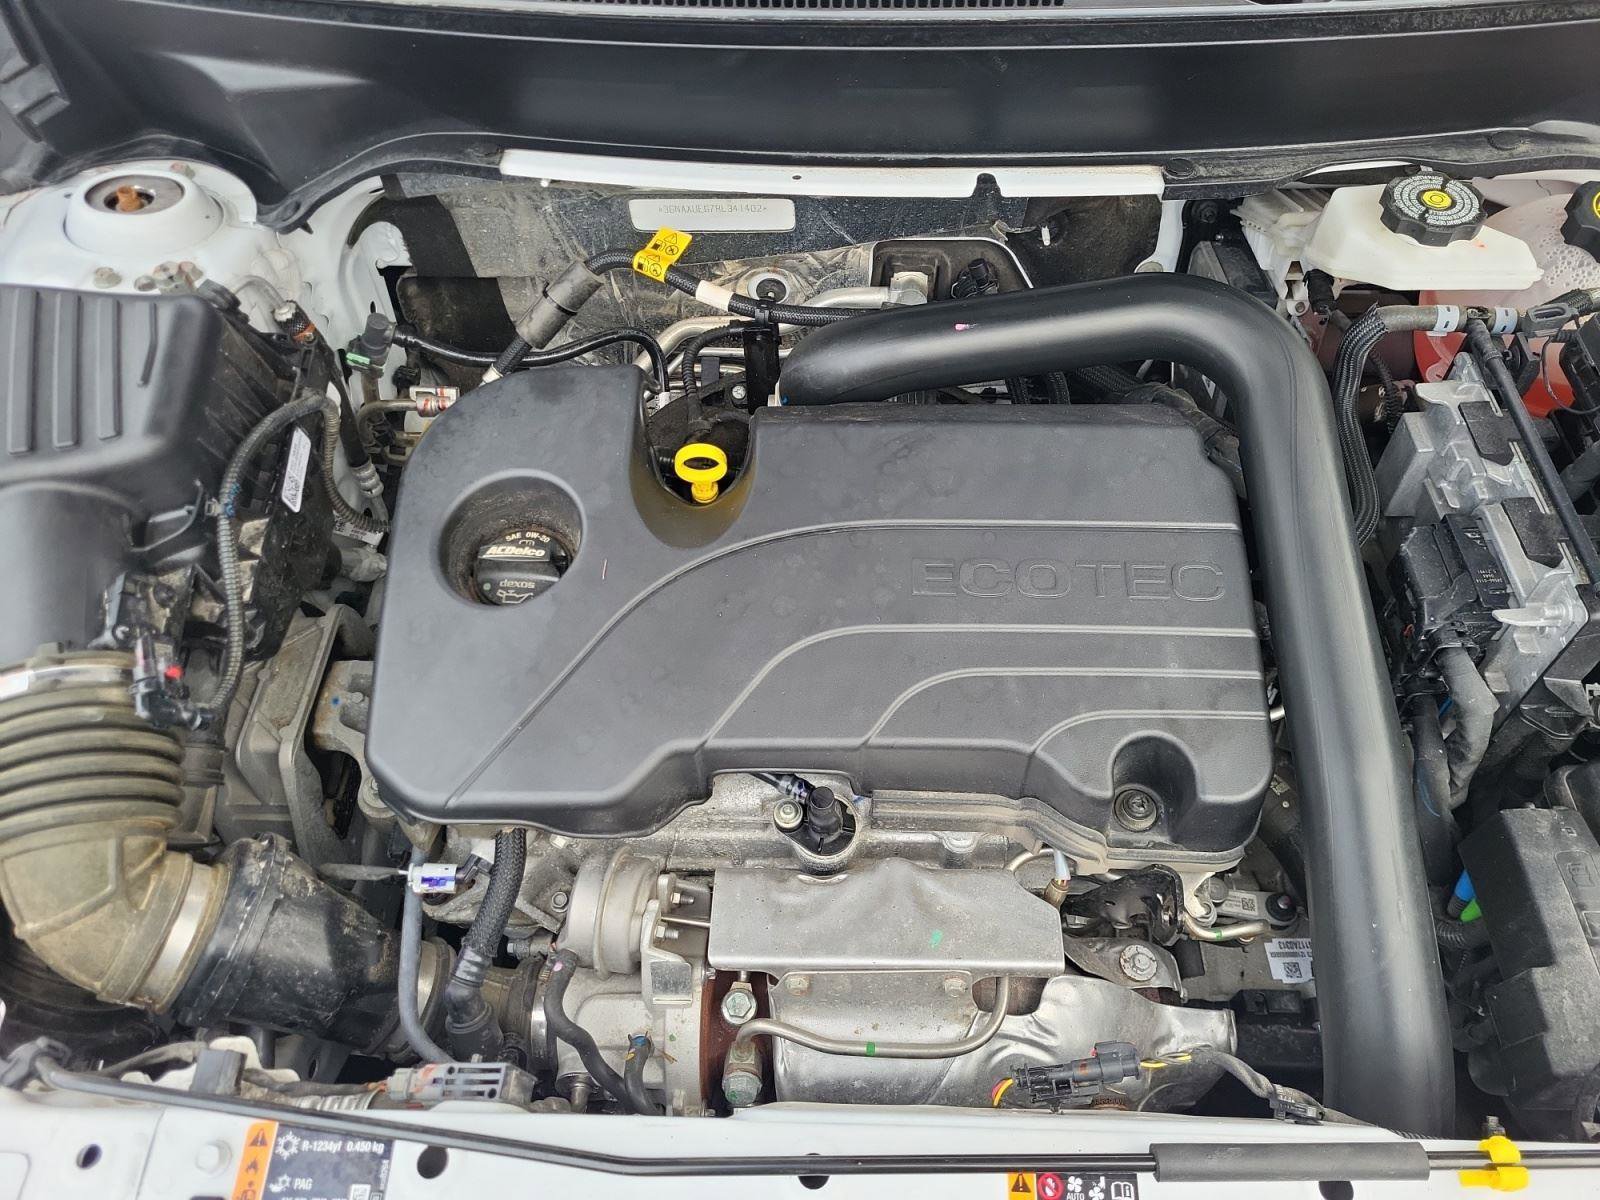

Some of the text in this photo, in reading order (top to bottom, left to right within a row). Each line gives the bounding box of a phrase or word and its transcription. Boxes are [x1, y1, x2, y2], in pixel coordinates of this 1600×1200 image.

[505, 531, 551, 543] SAE 0W-20
[486, 546, 546, 557] ACDelco
[499, 579, 536, 589] dexos
[912, 557, 1226, 601] ECOTEC
[372, 1141, 385, 1154] kg
[293, 1178, 313, 1190] PAG
